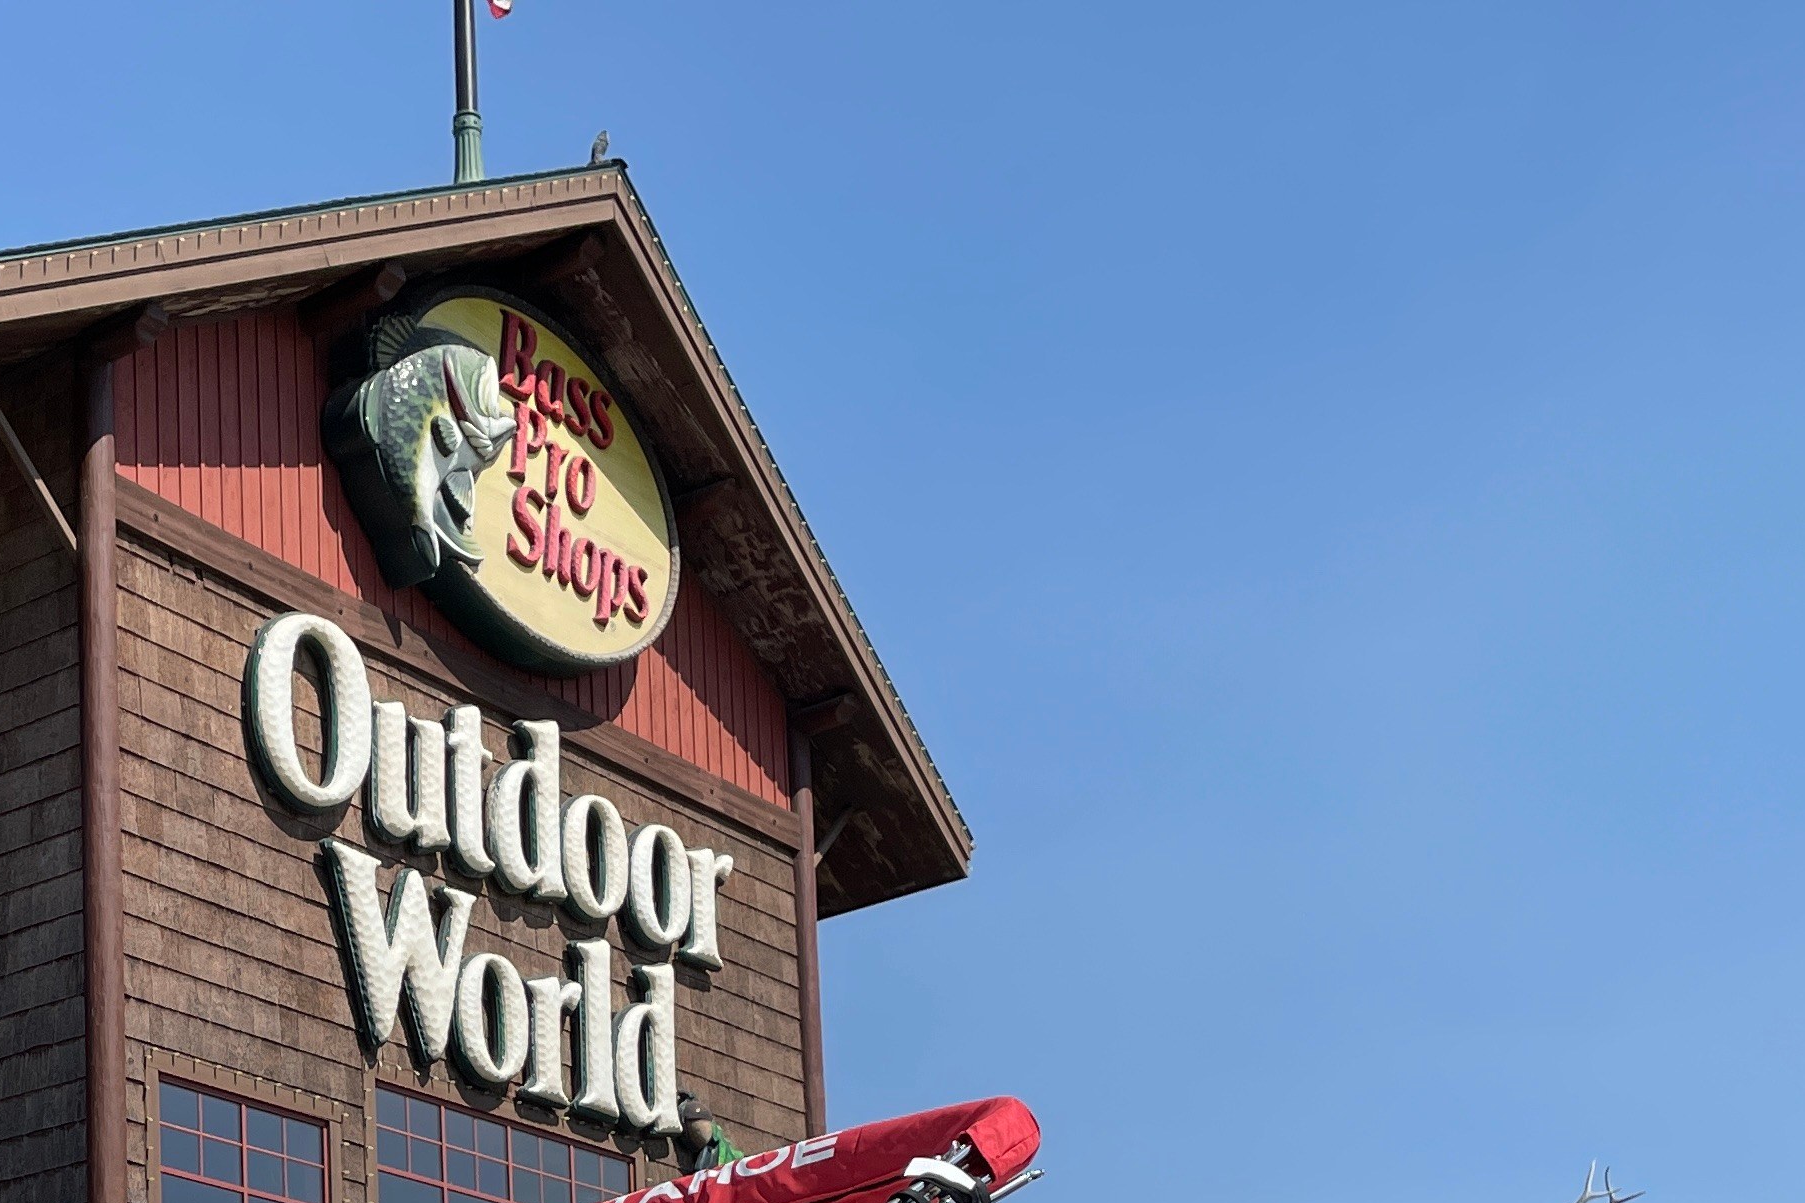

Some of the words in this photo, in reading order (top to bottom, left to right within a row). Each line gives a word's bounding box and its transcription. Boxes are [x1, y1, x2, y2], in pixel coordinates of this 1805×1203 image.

[498, 307, 616, 450] Bass
[506, 400, 597, 517] Pro
[506, 484, 650, 626] Shops
[244, 611, 734, 971] Outdoor
[319, 837, 684, 1136] World
